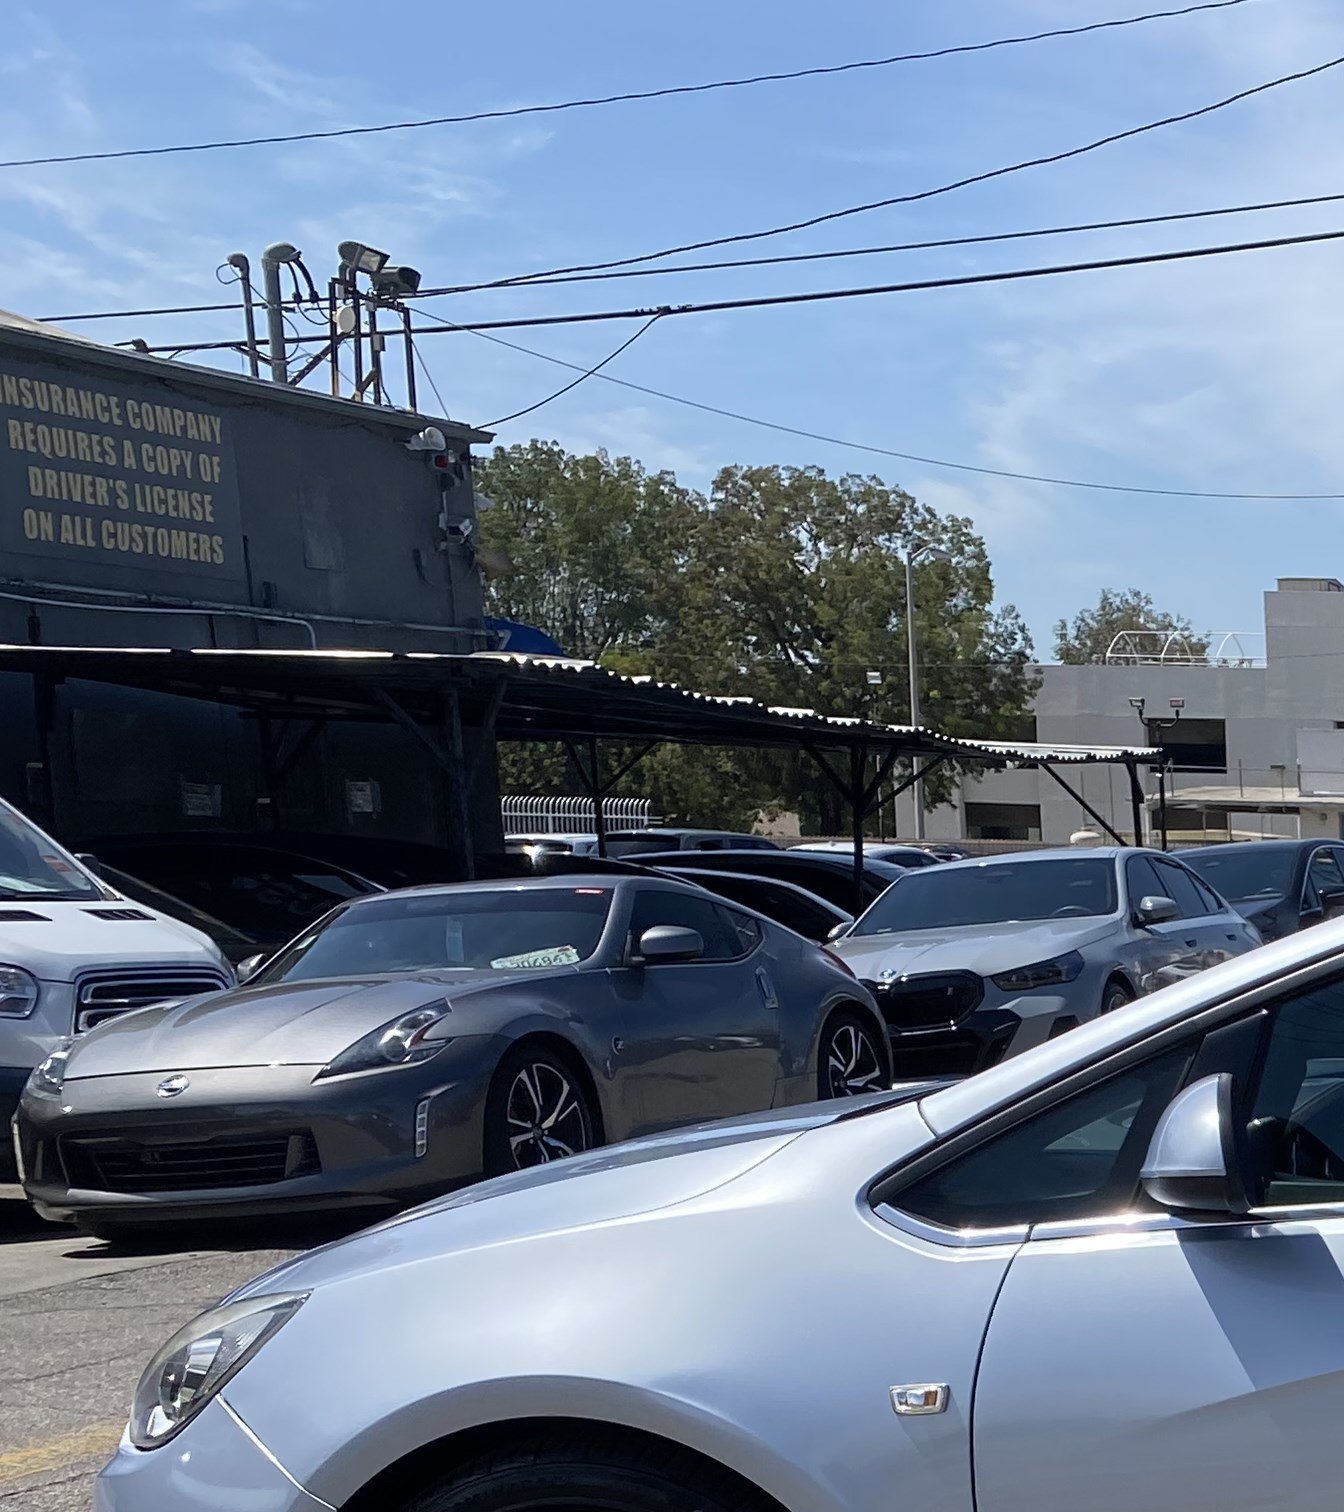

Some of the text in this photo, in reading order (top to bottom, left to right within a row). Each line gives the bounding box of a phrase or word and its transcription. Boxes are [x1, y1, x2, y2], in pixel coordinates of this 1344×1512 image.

[7, 418, 221, 484] REQUIRES A COPY OF
[126, 399, 222, 445] COMPANY
[28, 466, 215, 524] DRIVER'S LICENSE
[23, 507, 225, 566] ON ALL CUSTOMERS
